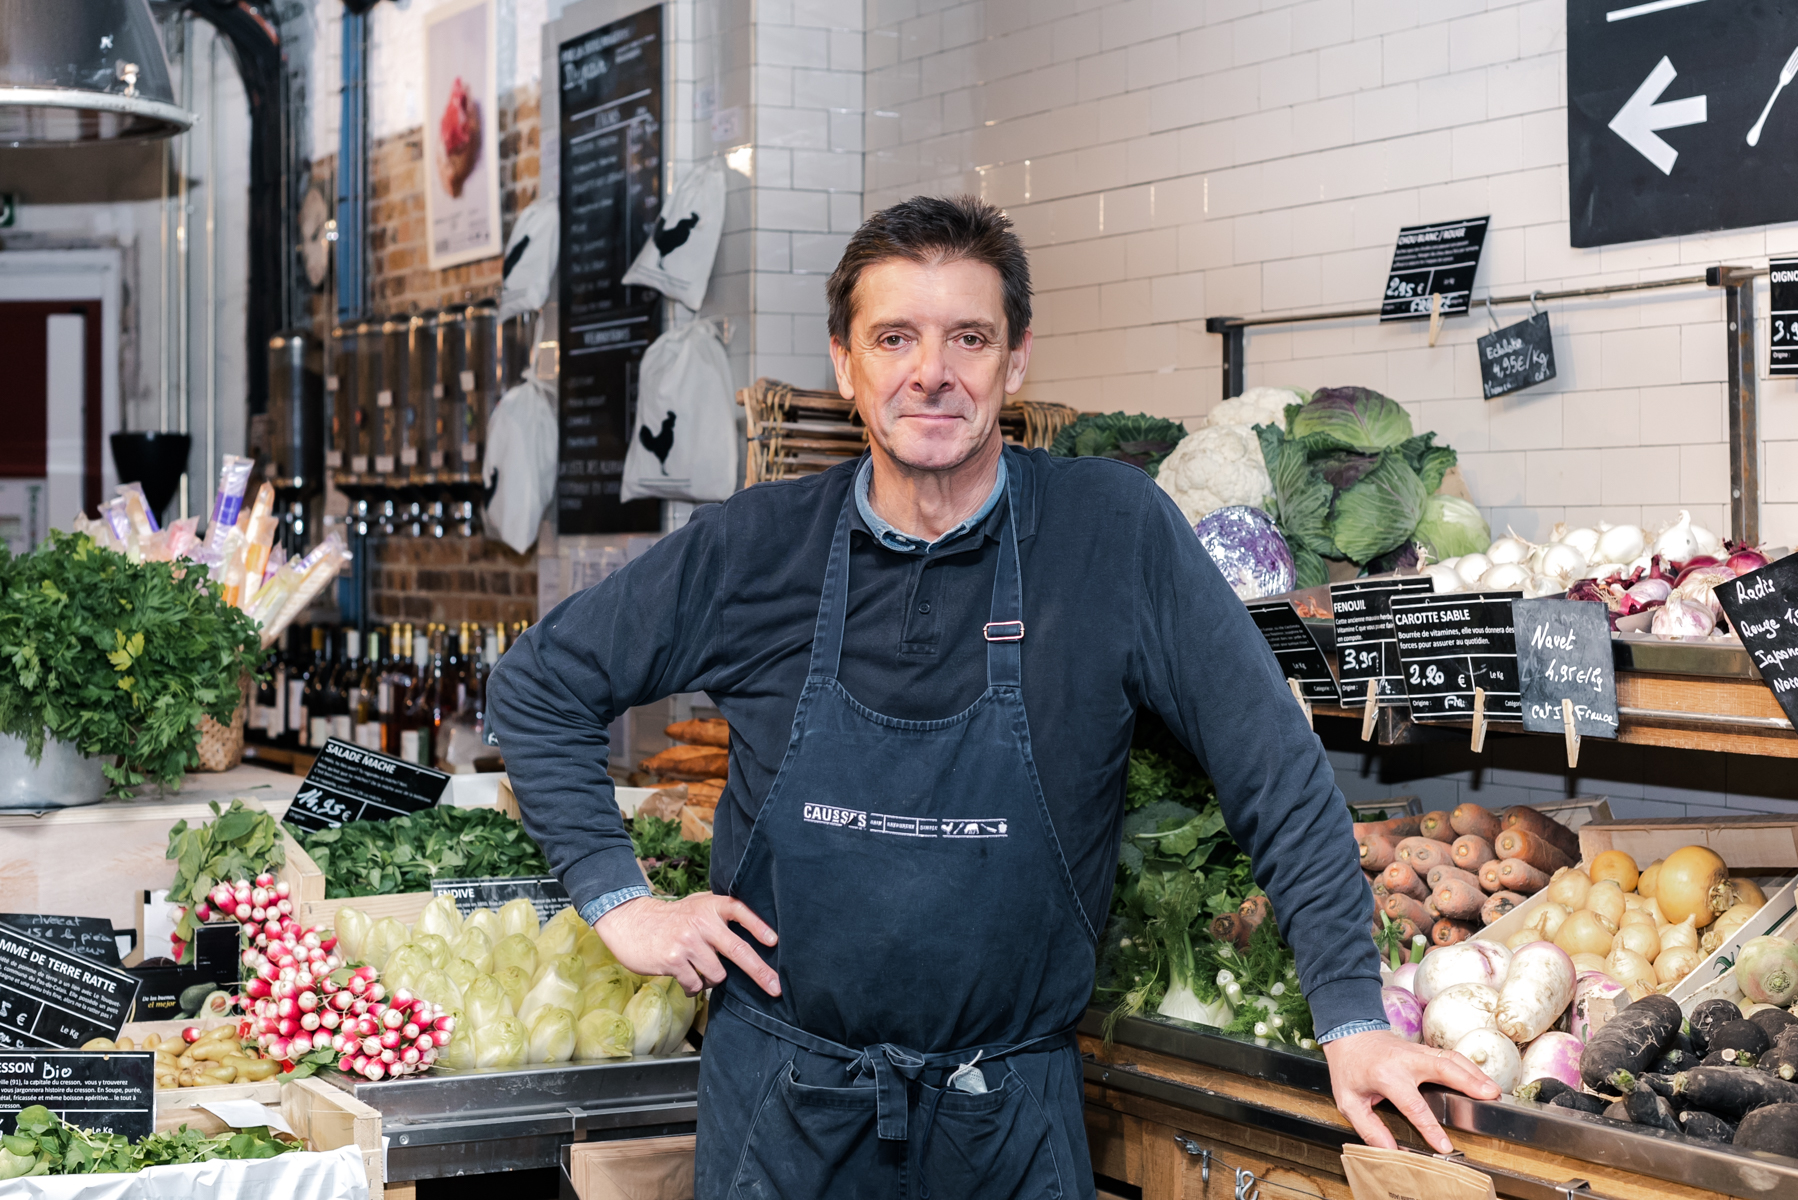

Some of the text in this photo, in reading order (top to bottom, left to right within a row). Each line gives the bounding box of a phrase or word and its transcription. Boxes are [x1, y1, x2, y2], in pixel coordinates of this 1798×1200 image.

[1736, 576, 1776, 604] Radis
[1334, 600, 1366, 613] FENOUIL
[1395, 609, 1470, 625] CAROTTE SABLE
[1398, 631, 1420, 639] Bourrée
[1422, 630, 1429, 638] de
[1430, 628, 1460, 637] vitamines,
[1461, 626, 1471, 634] elle
[1484, 626, 1504, 634] donnera
[1506, 626, 1515, 634] des
[1531, 622, 1576, 650] Navet
[1740, 619, 1780, 639] Rouge
[1400, 642, 1418, 650] forces
[1418, 640, 1431, 650] pour
[1432, 639, 1454, 647] assurer
[1464, 637, 1490, 646] quotidien.
[1410, 664, 1445, 686] 2,20
[1458, 674, 1467, 688] €
[1496, 671, 1504, 680] Kg
[1505, 700, 1522, 708] Catégori
[1574, 705, 1618, 726] France
[326, 744, 362, 763] SALADE
[362, 755, 396, 774] MACHE
[32, 914, 80, 926] Avocat
[10, 959, 18, 967] de
[18, 964, 37, 975] pomme
[38, 970, 44, 978] de
[46, 973, 58, 983] terre
[71, 982, 80, 992] lien
[81, 988, 93, 997] avec
[93, 992, 100, 1000] Le
[30, 951, 46, 966] DE
[48, 958, 82, 980] TERRE
[82, 972, 117, 994] RATTE
[4, 966, 28, 979] commune
[28, 974, 36, 982] du
[36, 978, 68, 995] Pas-de-Calais.
[68, 990, 78, 1000] Elle
[78, 994, 98, 1007] possède
[106, 1004, 118, 1014] petit
[20, 980, 30, 988] une
[30, 984, 42, 993] peau
[42, 988, 52, 996] très
[52, 990, 62, 1000] fine,
[63, 996, 75, 1006] alors
[100, 1010, 109, 1020] pas
[156, 1000, 176, 1008] mejor
[16, 1012, 28, 1026] €
[60, 1025, 69, 1034] Le
[69, 1030, 80, 1040] Kg
[0, 1062, 34, 1074] SSON
[30, 1079, 50, 1087] capitale
[105, 1087, 124, 1095] Soupe,
[124, 1087, 142, 1095] purée,
[84, 1094, 114, 1102] apéritive...
[92, 1126, 101, 1134] Le
